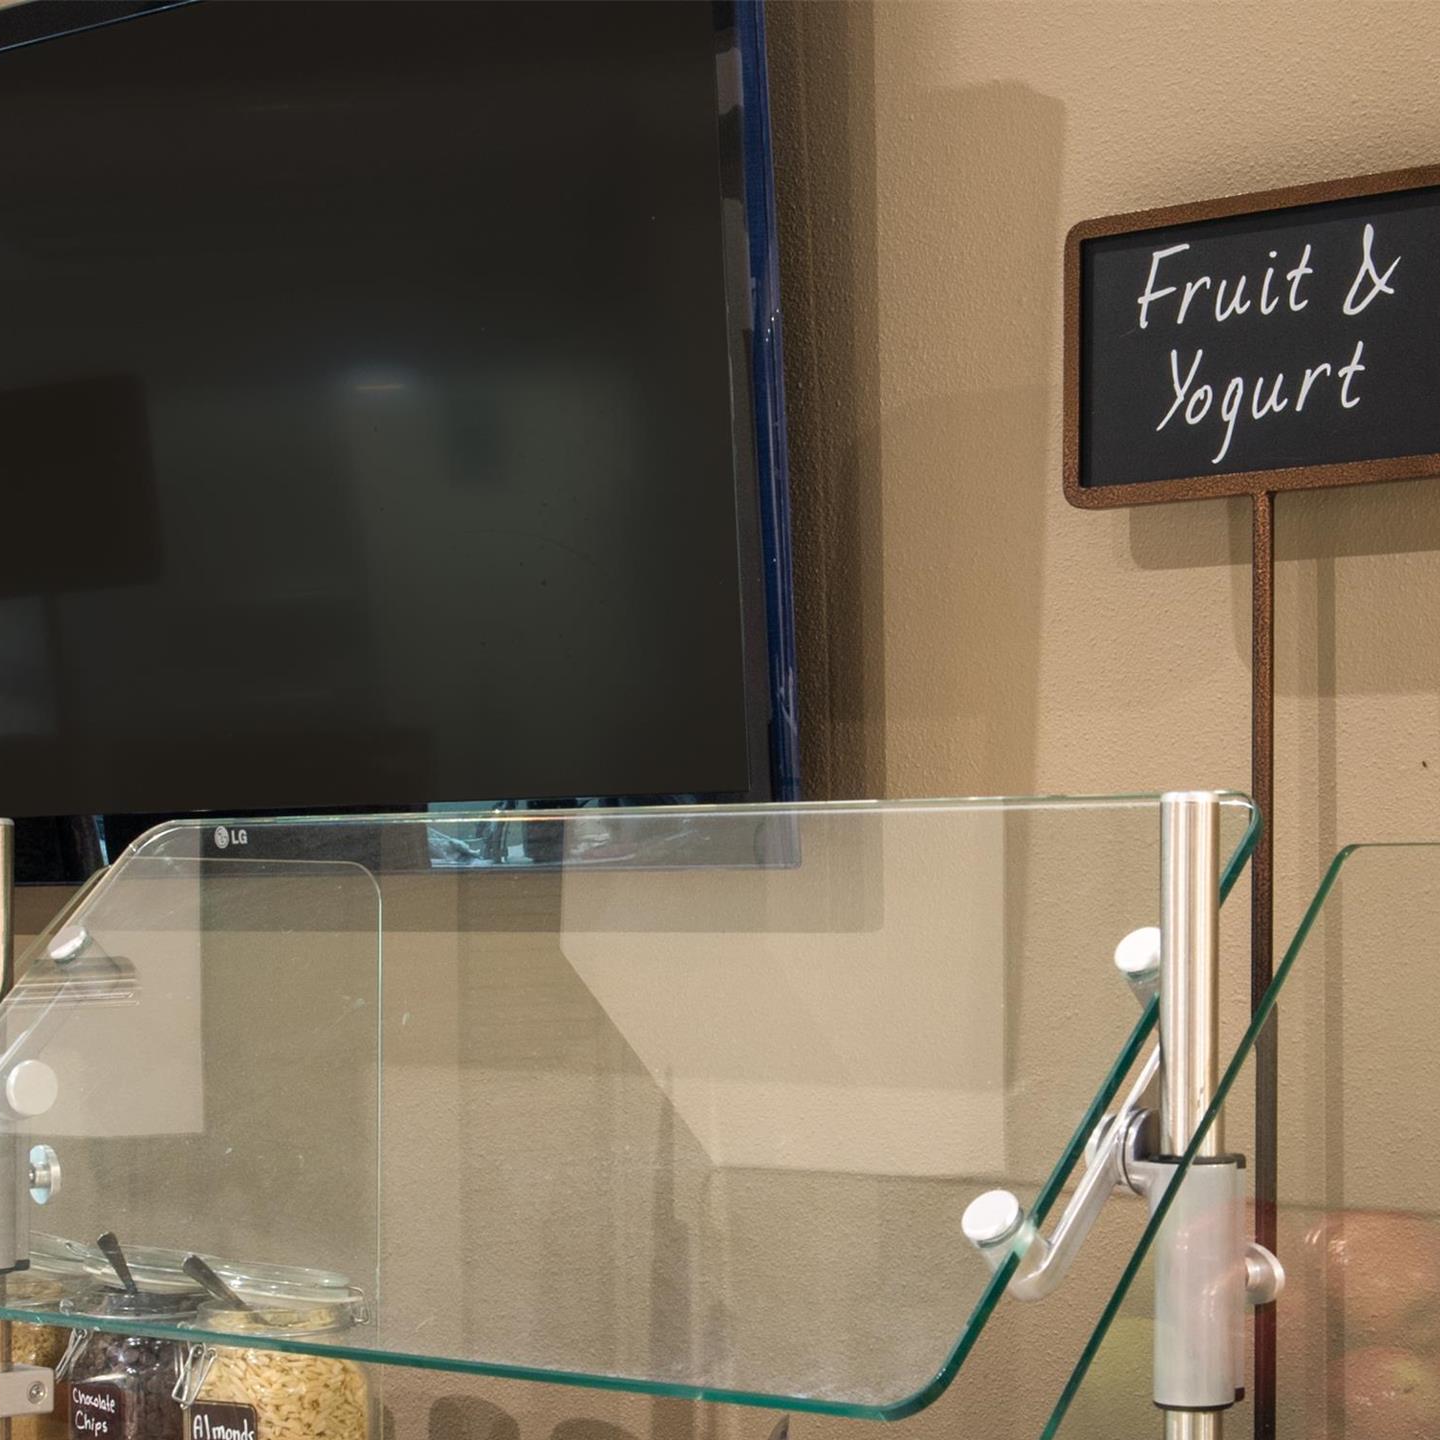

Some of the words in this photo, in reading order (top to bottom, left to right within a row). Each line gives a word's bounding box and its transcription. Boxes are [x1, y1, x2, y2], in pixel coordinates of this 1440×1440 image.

[1137, 243, 1313, 329] Fruit
[1342, 223, 1402, 316] &
[1155, 340, 1365, 463] Yogurt
[231, 829, 248, 845] LG
[72, 1387, 116, 1414] Chocolate
[75, 1410, 108, 1437] Chips
